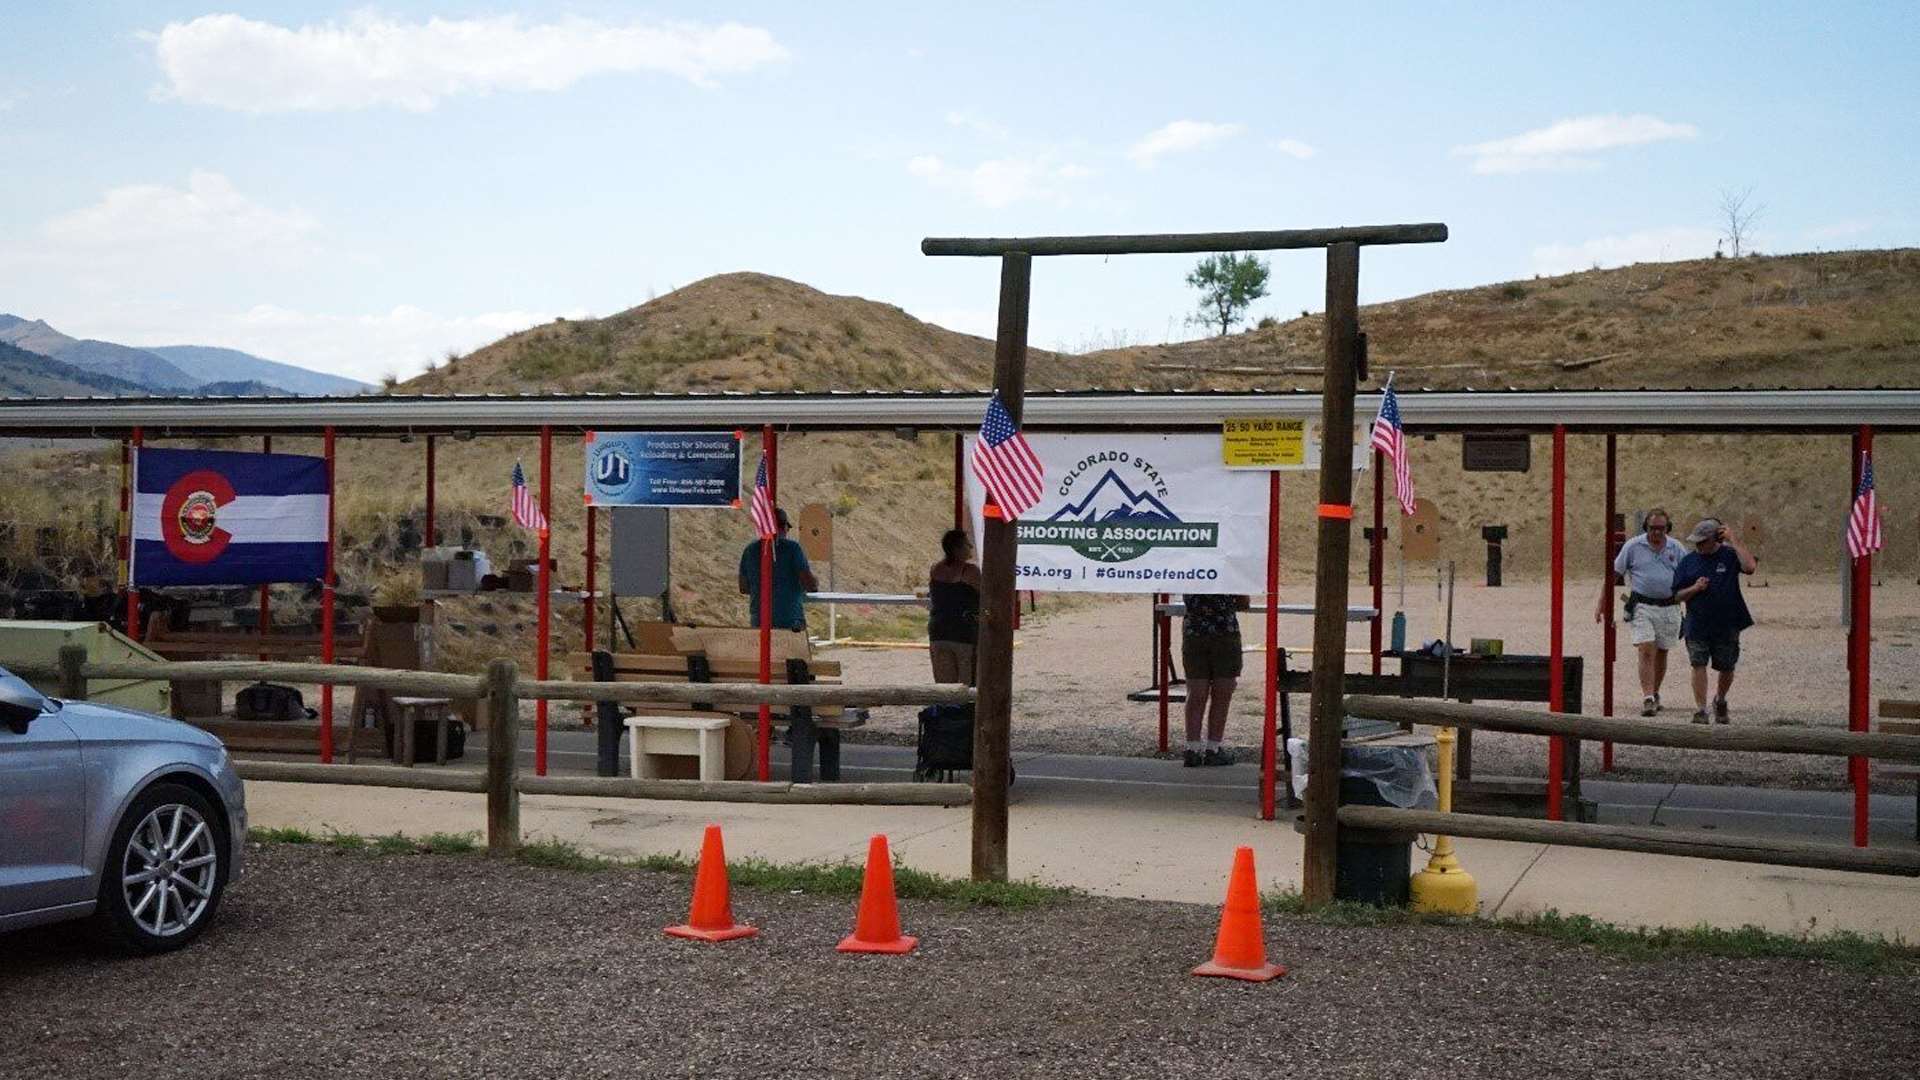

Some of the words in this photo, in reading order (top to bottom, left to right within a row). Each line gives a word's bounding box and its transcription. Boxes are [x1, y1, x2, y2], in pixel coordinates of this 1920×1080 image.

[1276, 421, 1304, 431] RANGE
[647, 441, 681, 450] Products
[695, 441, 731, 451] Shooting
[687, 451, 736, 461] Competition
[1059, 450, 1129, 496] COLORADO
[1133, 457, 1168, 498] STATE
[1016, 526, 1098, 540] SHOOTING
[1102, 527, 1212, 541] ASSOCIATION
[1014, 566, 1072, 580] SSA.org
[1096, 567, 1218, 580] #GunsDefendCO
